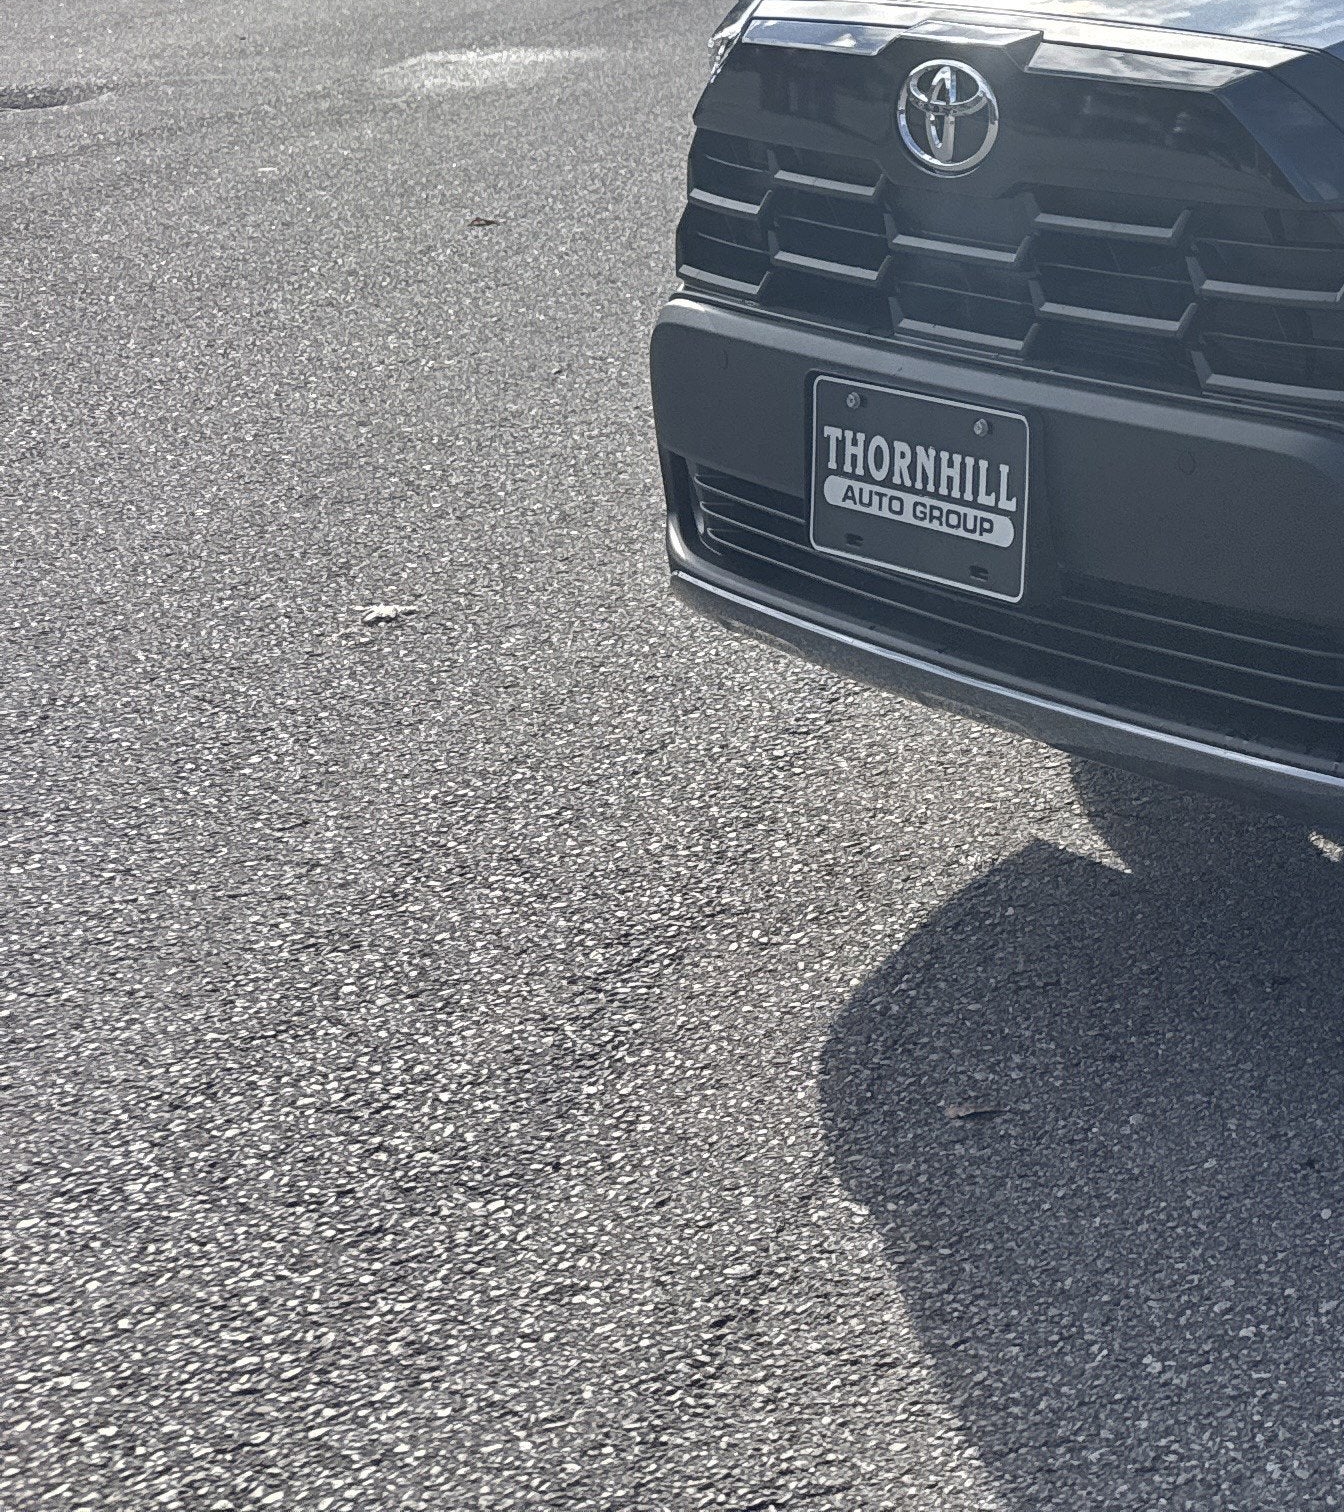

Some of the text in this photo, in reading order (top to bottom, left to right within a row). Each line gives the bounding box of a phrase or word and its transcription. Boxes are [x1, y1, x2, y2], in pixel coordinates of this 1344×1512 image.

[823, 425, 1017, 512] THORNHILL
[842, 484, 994, 537] AUTO GROUP
